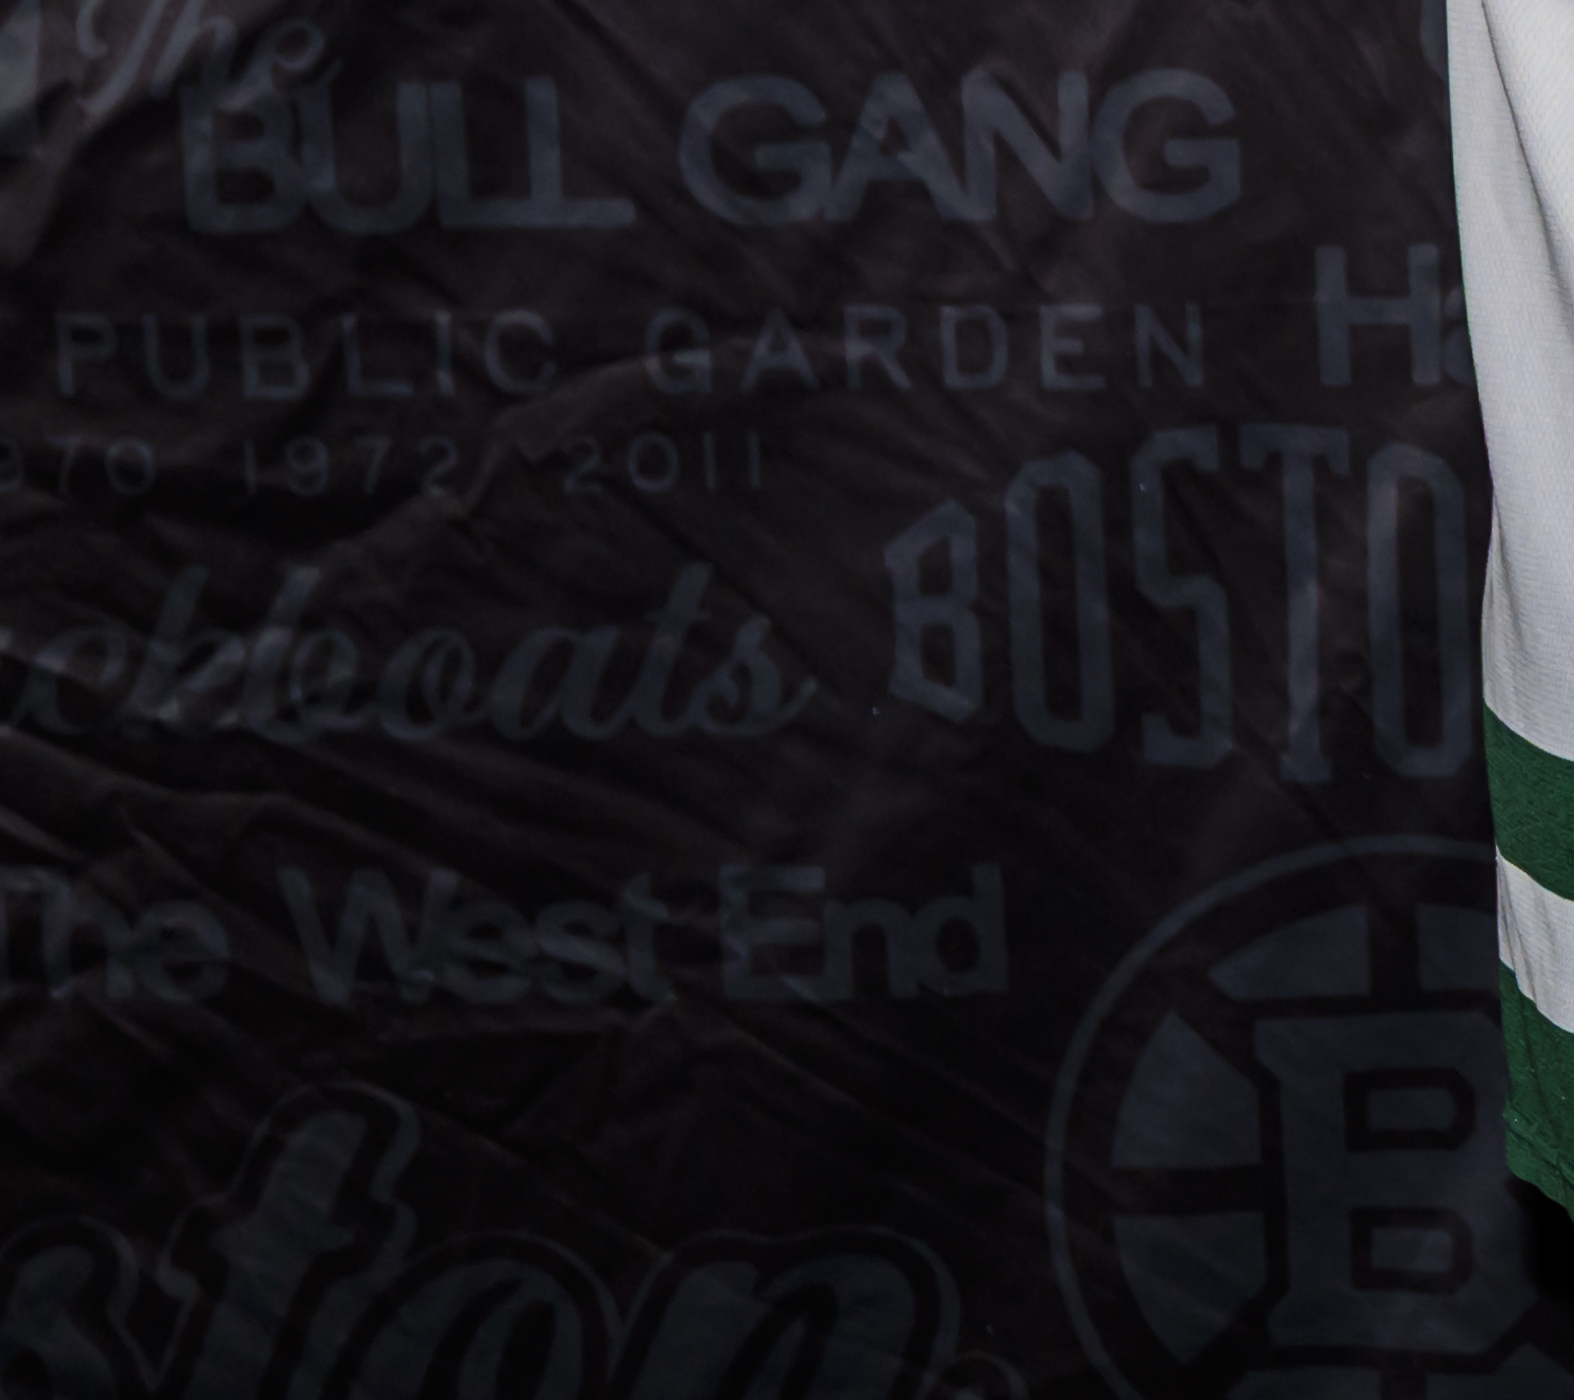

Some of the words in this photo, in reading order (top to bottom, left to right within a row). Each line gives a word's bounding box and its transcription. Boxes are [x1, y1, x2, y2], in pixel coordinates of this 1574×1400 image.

[181, 76, 638, 236] BULL
[677, 64, 1244, 228] GANG
[55, 306, 558, 400] PUBLIC
[644, 303, 1205, 398] GARDEN
[244, 435, 459, 498] 1972
[563, 431, 766, 498] 2011
[277, 863, 676, 1008] West
[719, 861, 1011, 1001] End
